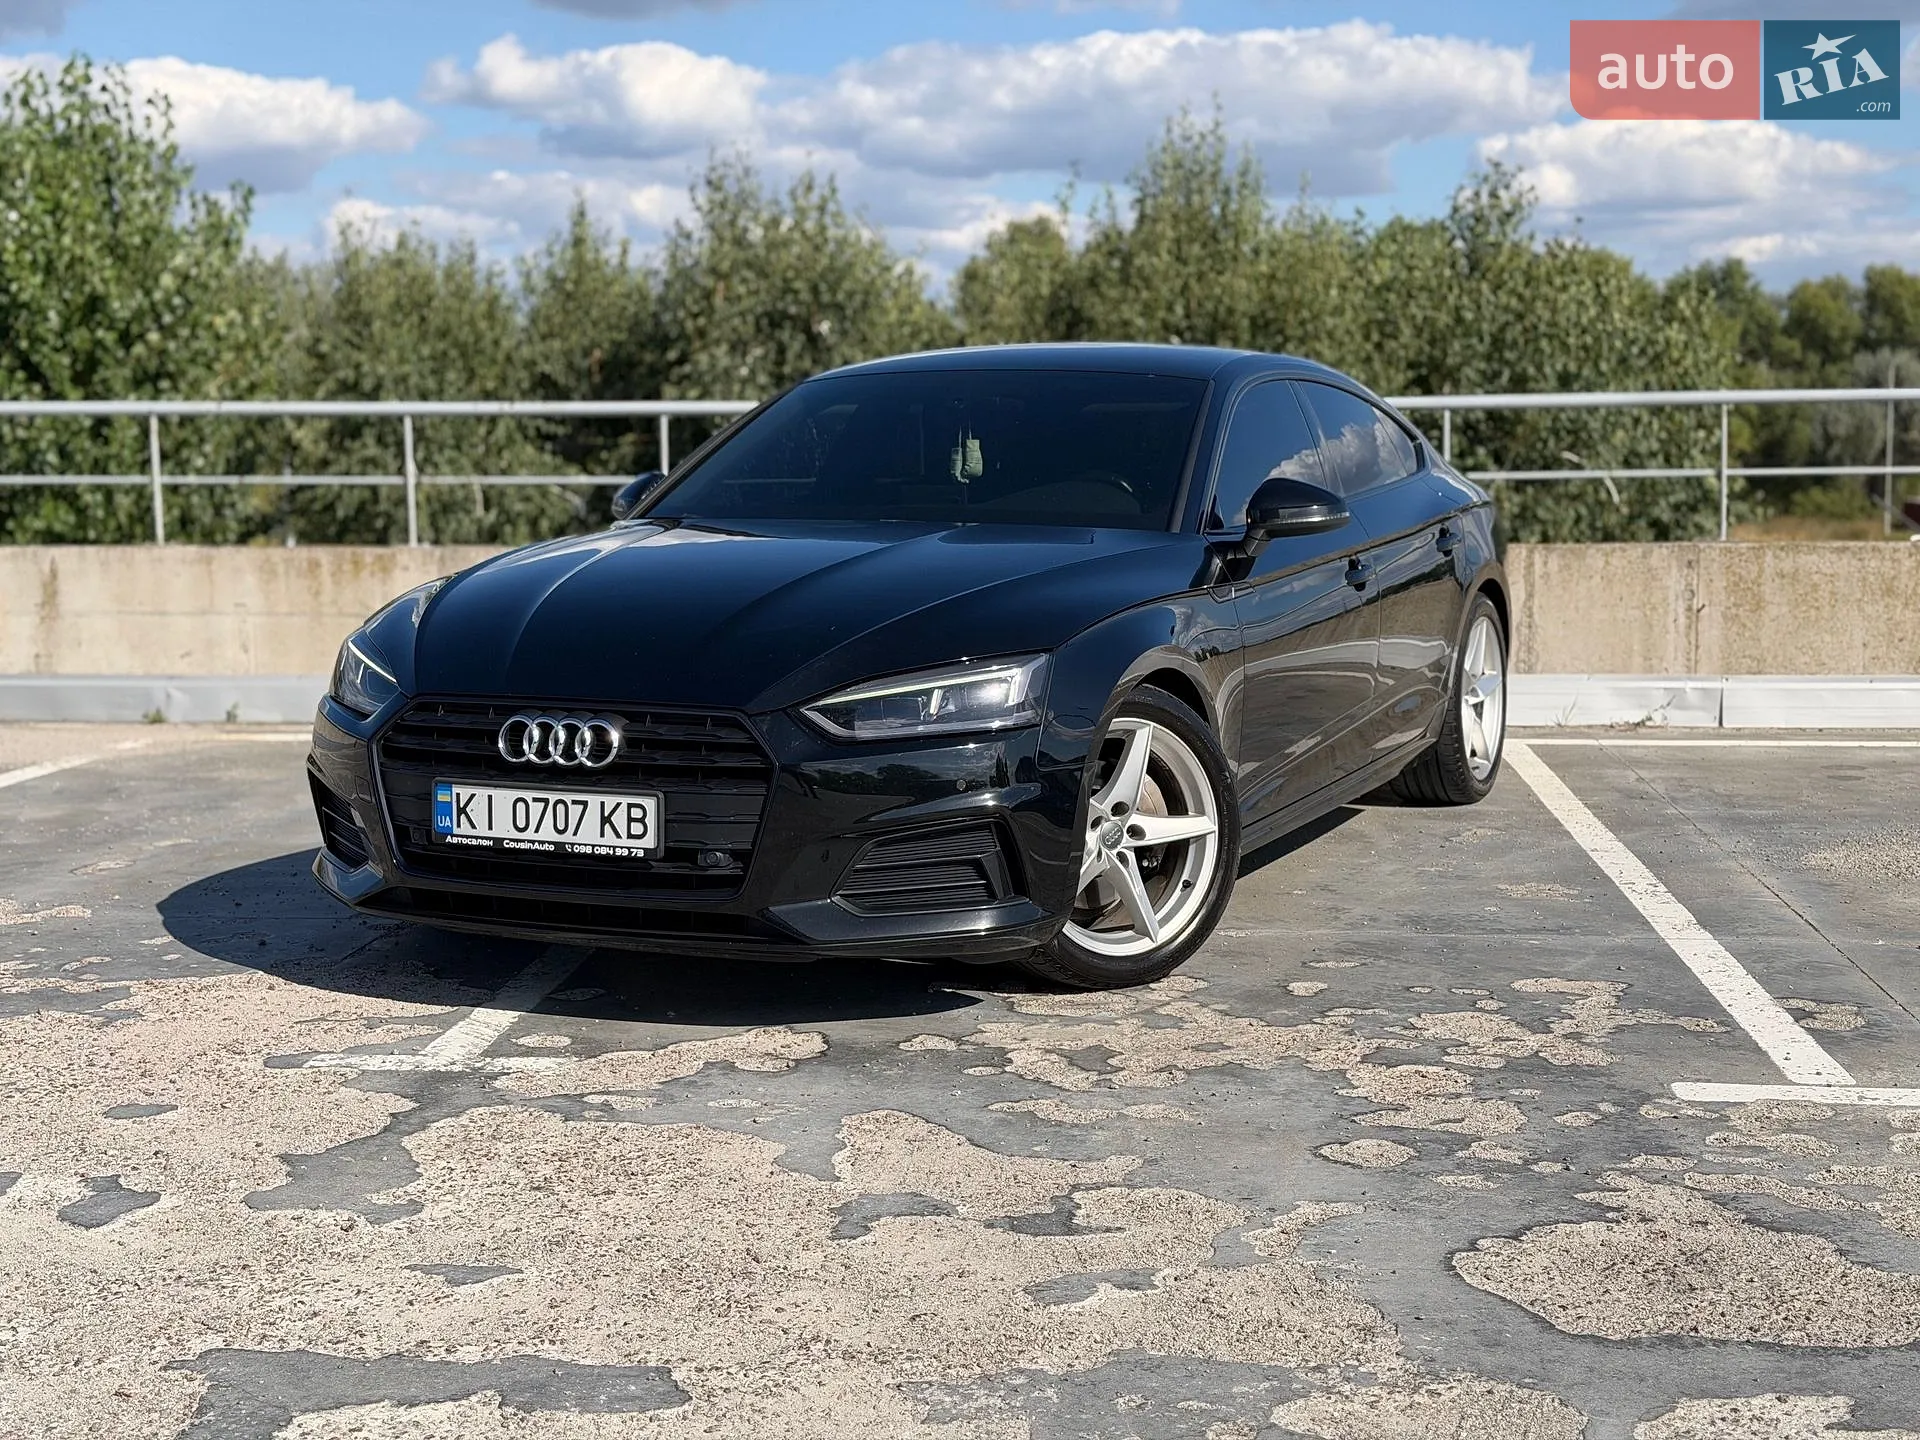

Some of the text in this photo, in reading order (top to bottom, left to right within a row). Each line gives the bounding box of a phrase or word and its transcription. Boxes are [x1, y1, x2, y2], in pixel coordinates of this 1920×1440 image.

[438, 815, 452, 828] UA
[512, 796, 590, 837] 0707
[599, 800, 649, 840] KB
[445, 834, 494, 847] Автосалон
[503, 839, 555, 851] CousinAuto
[573, 844, 593, 854] 098
[594, 845, 614, 855] 084
[615, 847, 629, 856] 99
